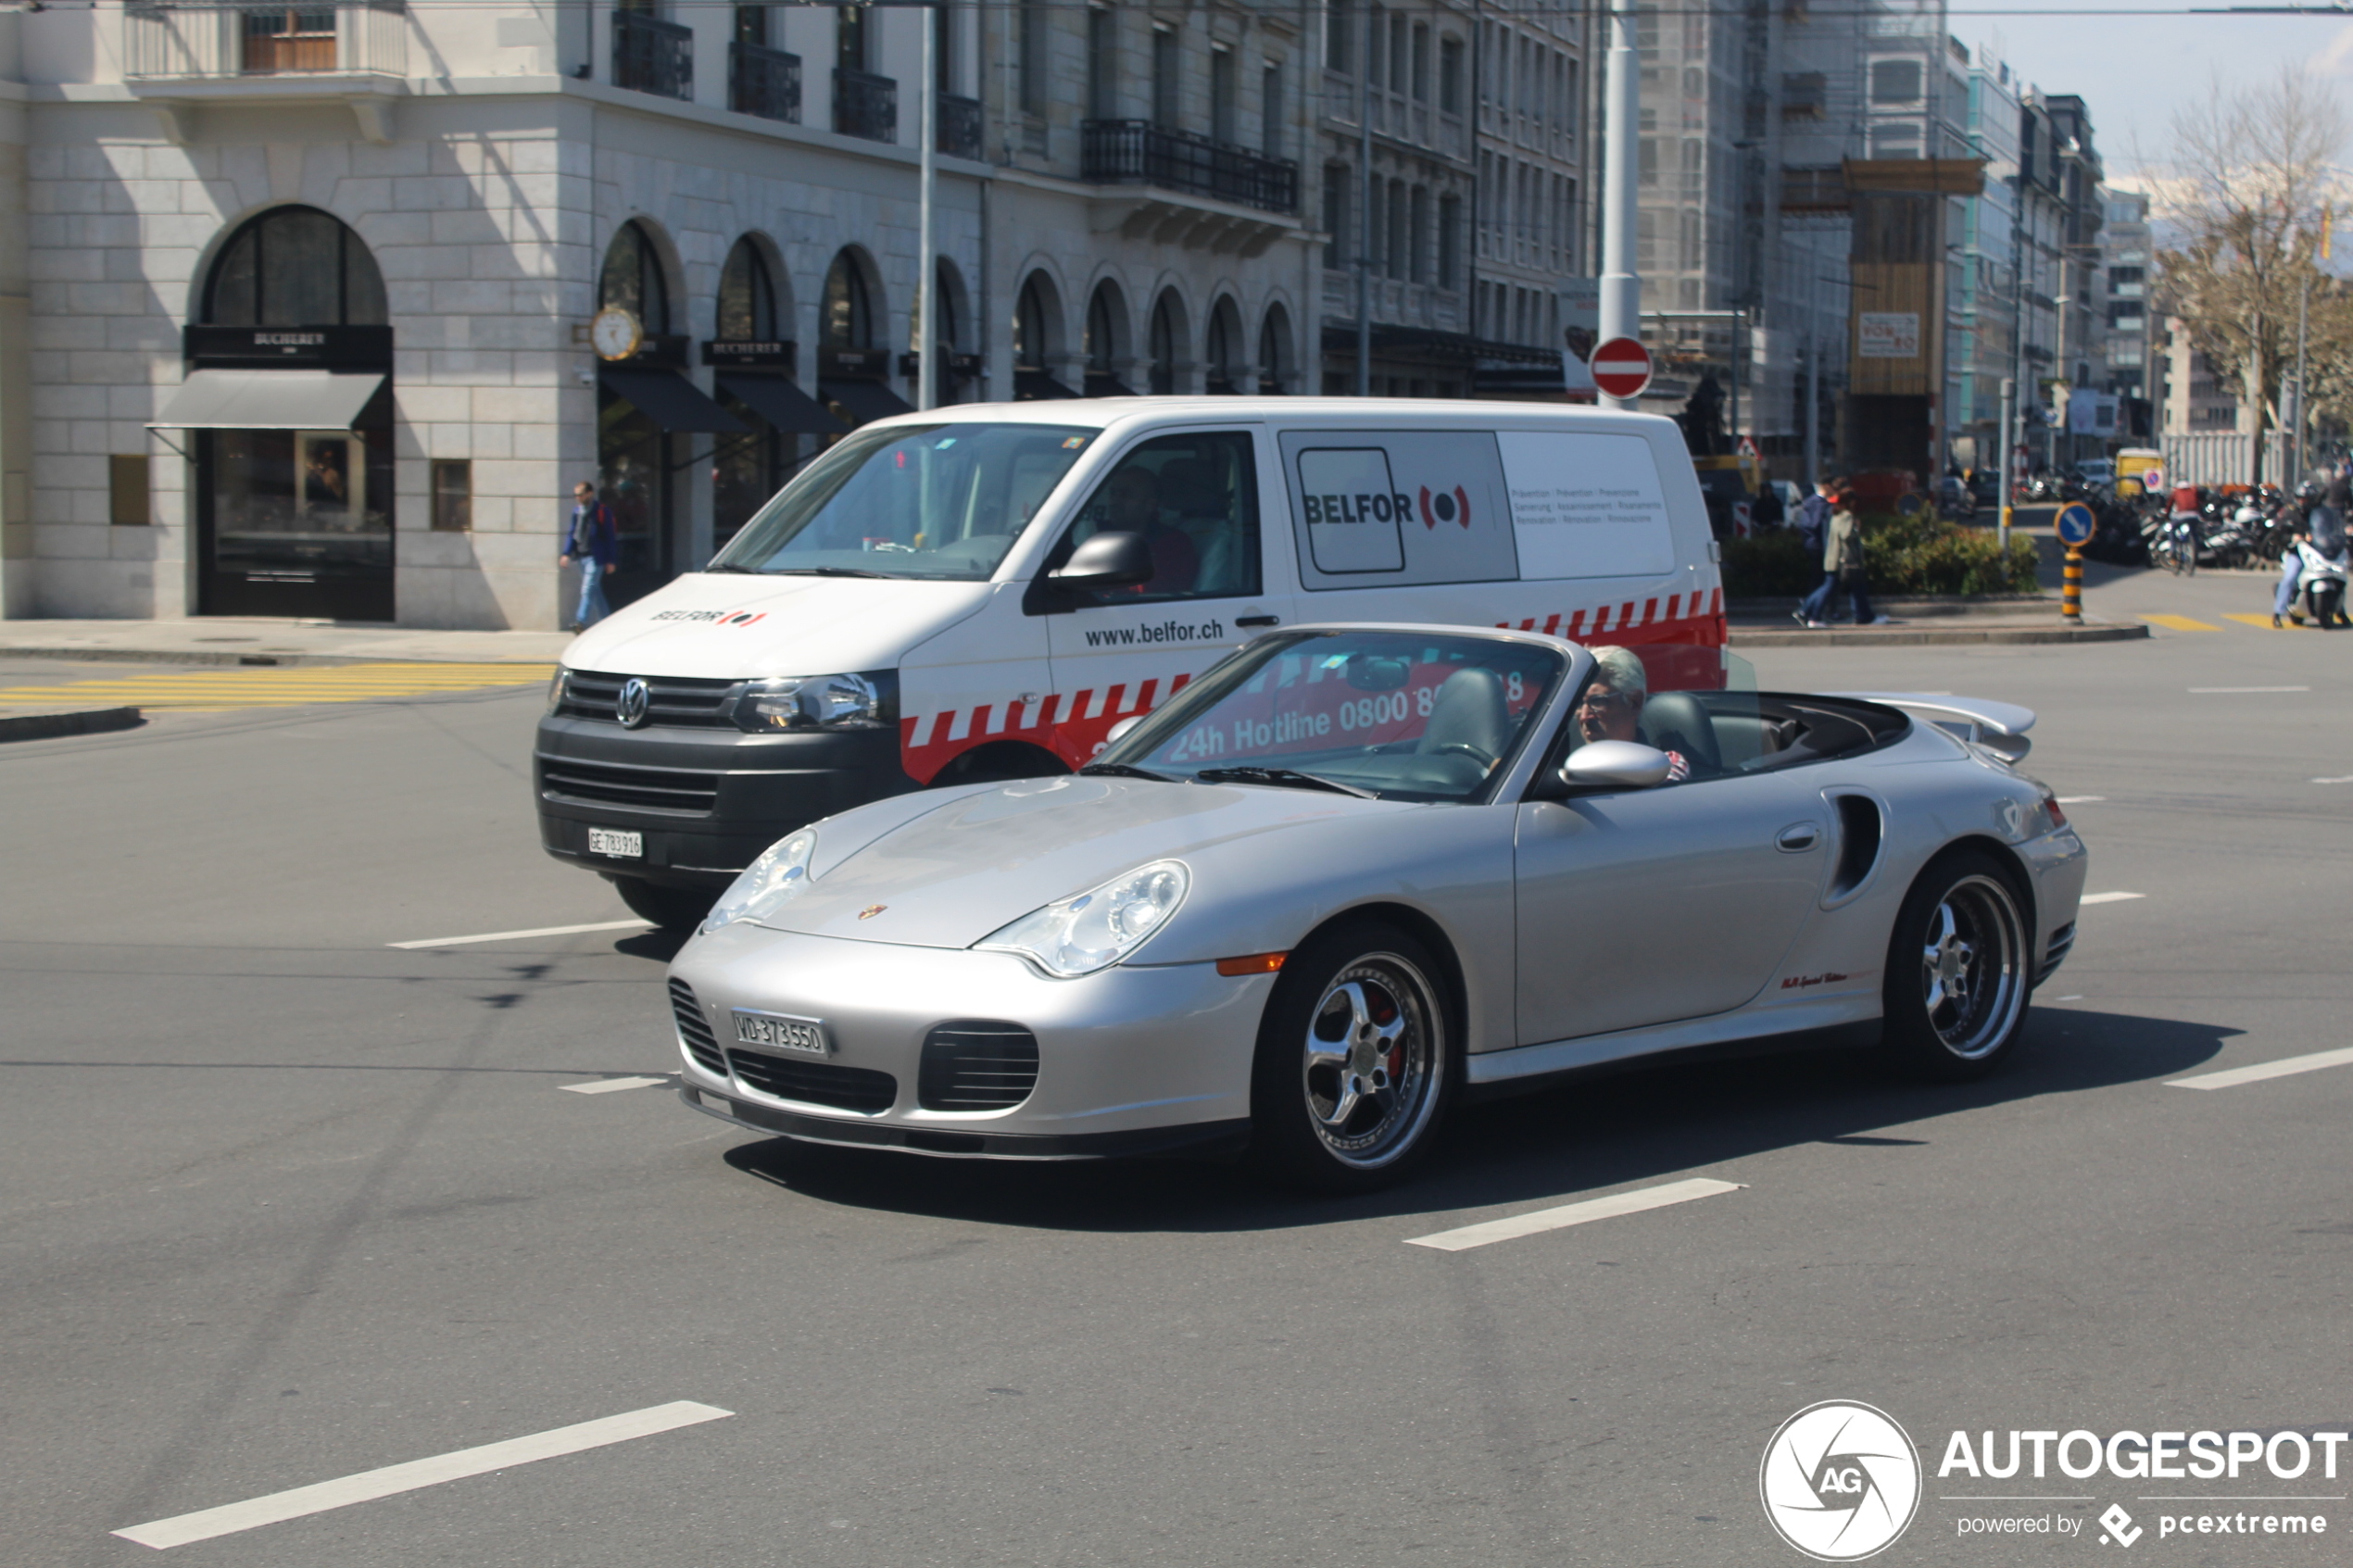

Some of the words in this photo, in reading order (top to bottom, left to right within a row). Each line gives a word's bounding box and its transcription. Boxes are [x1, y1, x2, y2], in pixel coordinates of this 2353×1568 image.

[712, 343, 782, 354] BUCHERER
[1304, 494, 1414, 524] BELFOR
[650, 610, 725, 621] BELFOR
[1086, 619, 1223, 646] www.belfor.ch
[1170, 726, 1224, 761] 24h
[1235, 711, 1330, 750] Hotline
[1340, 691, 1408, 731] 0800
